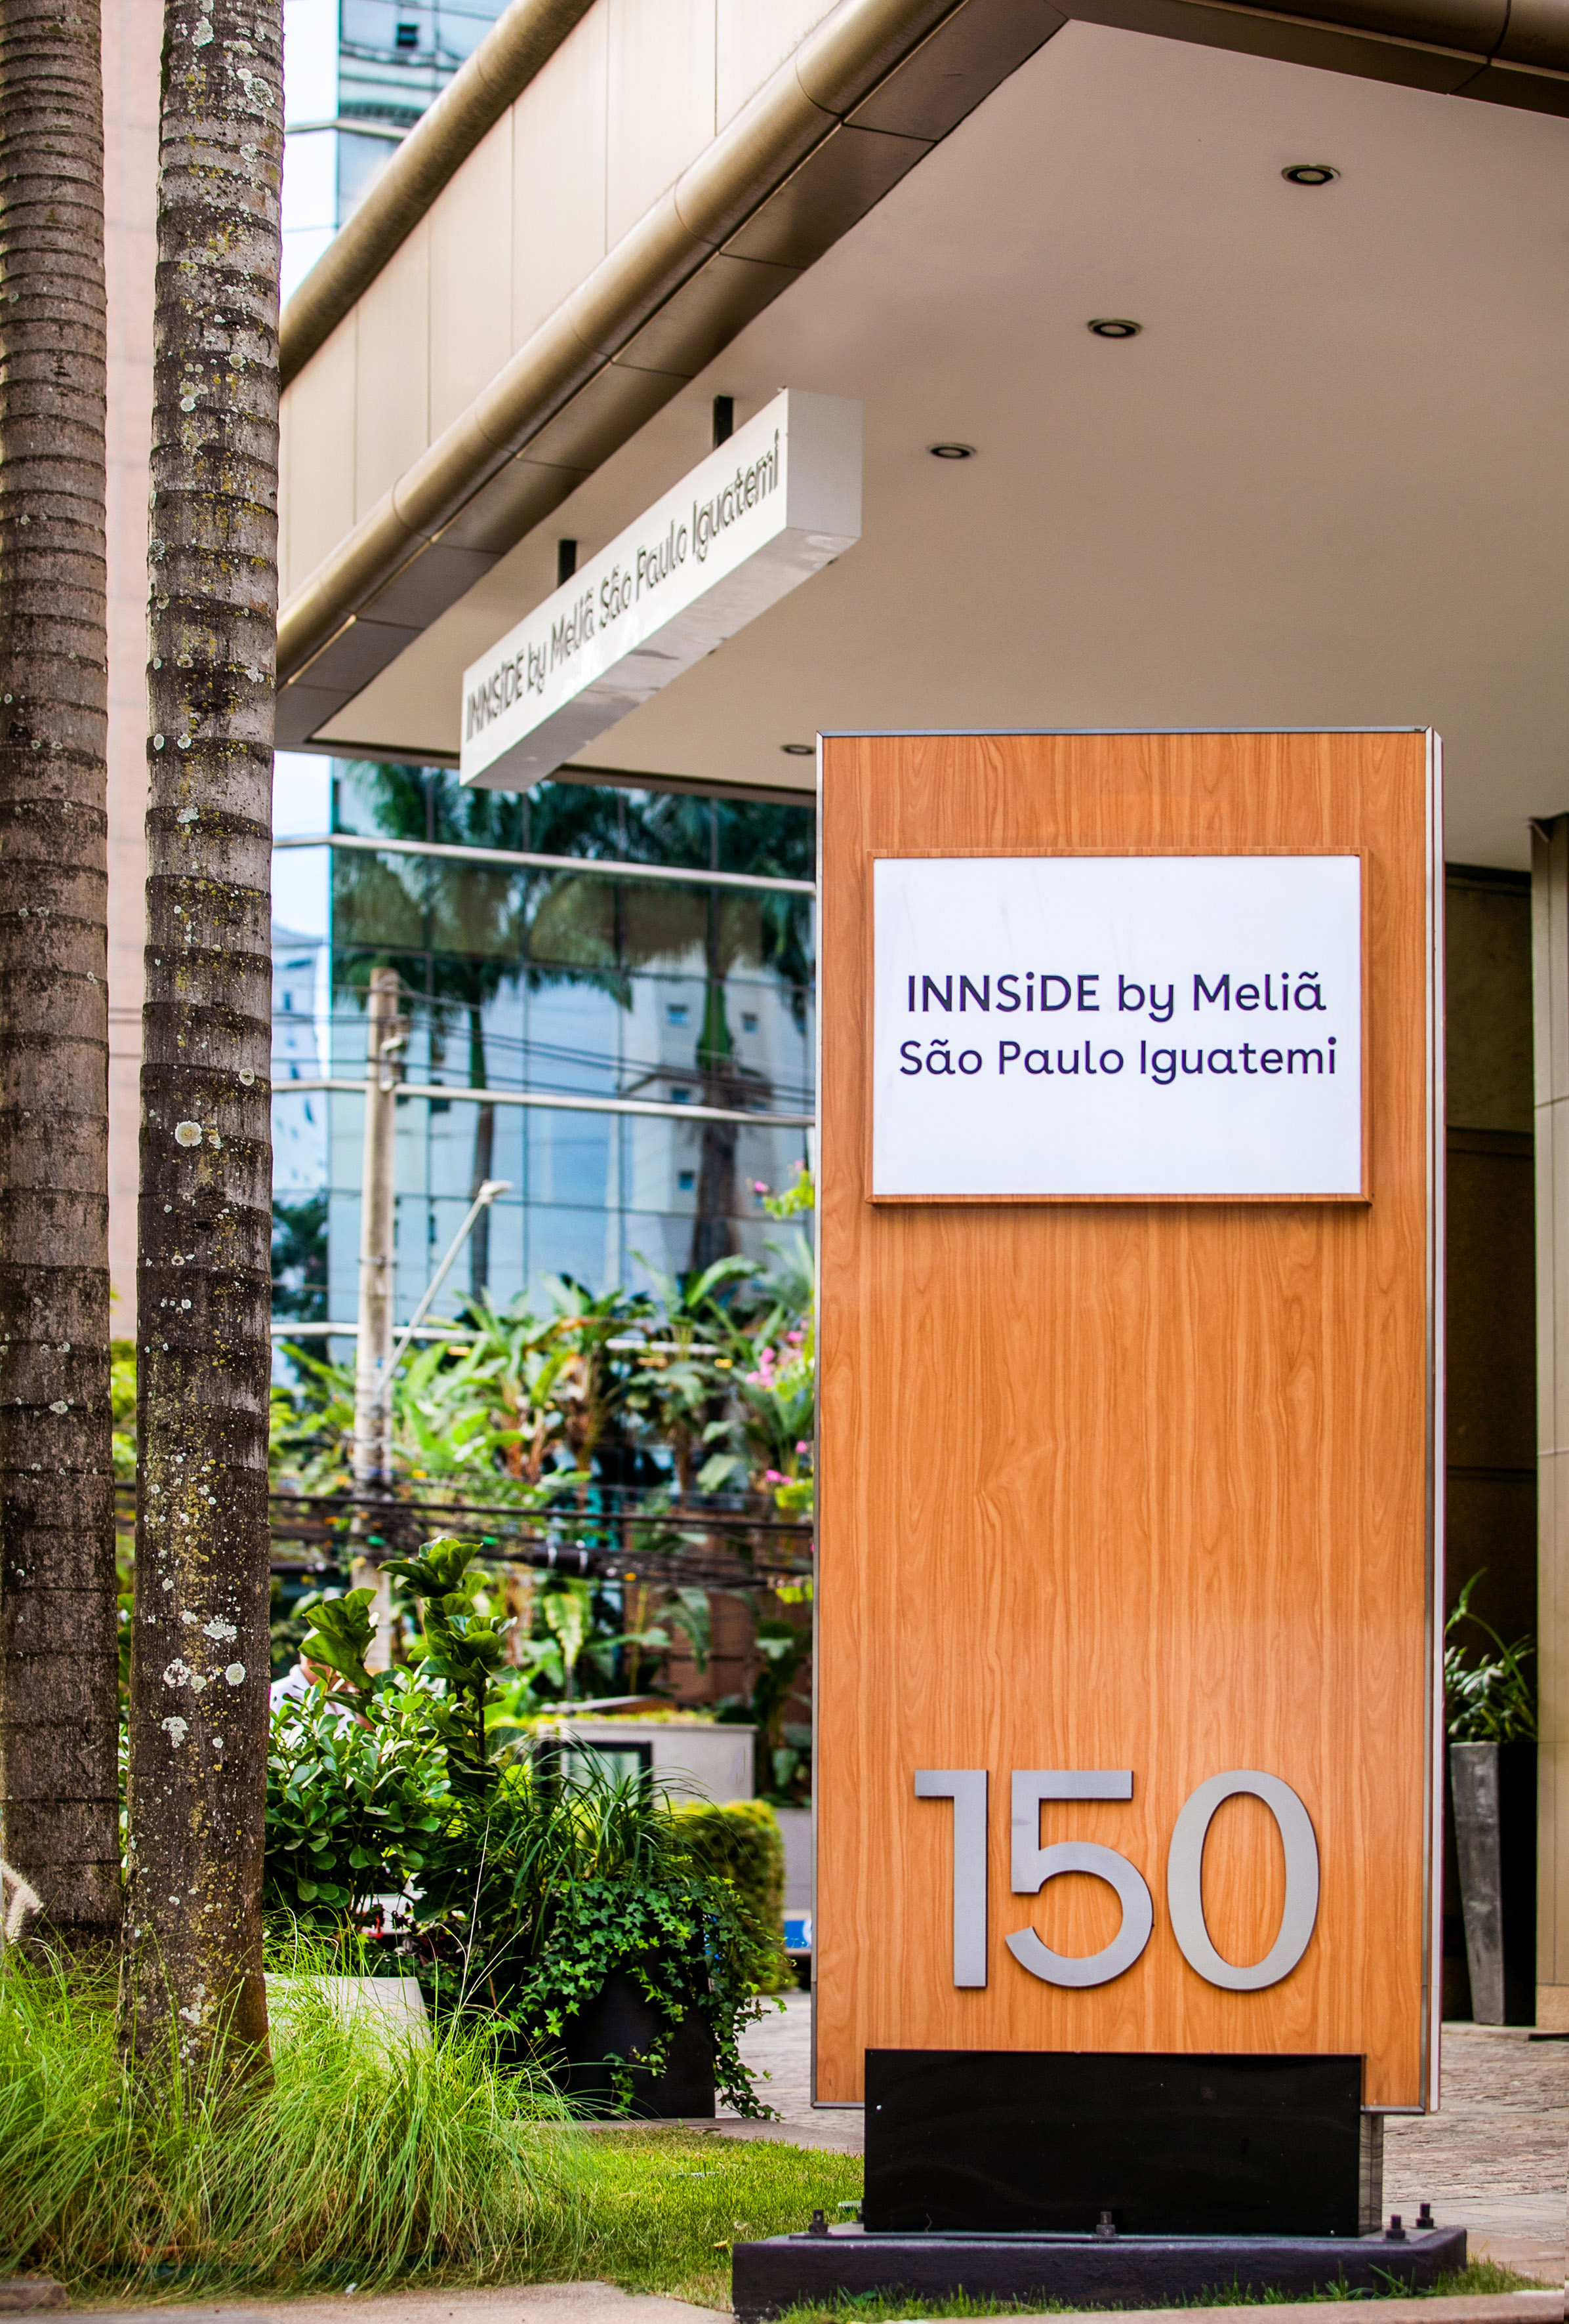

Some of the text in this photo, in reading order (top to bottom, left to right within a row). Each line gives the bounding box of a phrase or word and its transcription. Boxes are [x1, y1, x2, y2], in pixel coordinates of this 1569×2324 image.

[527, 642, 547, 695] by
[550, 587, 594, 673] Meliã
[599, 563, 631, 628] São
[636, 518, 687, 602] Paulo
[692, 428, 779, 564] Iguatemi
[899, 1036, 1337, 1086] São Paulo Iguatemi
[908, 971, 1327, 1023] INNSiDE by Meliã
[913, 1768, 1320, 1992] 150
